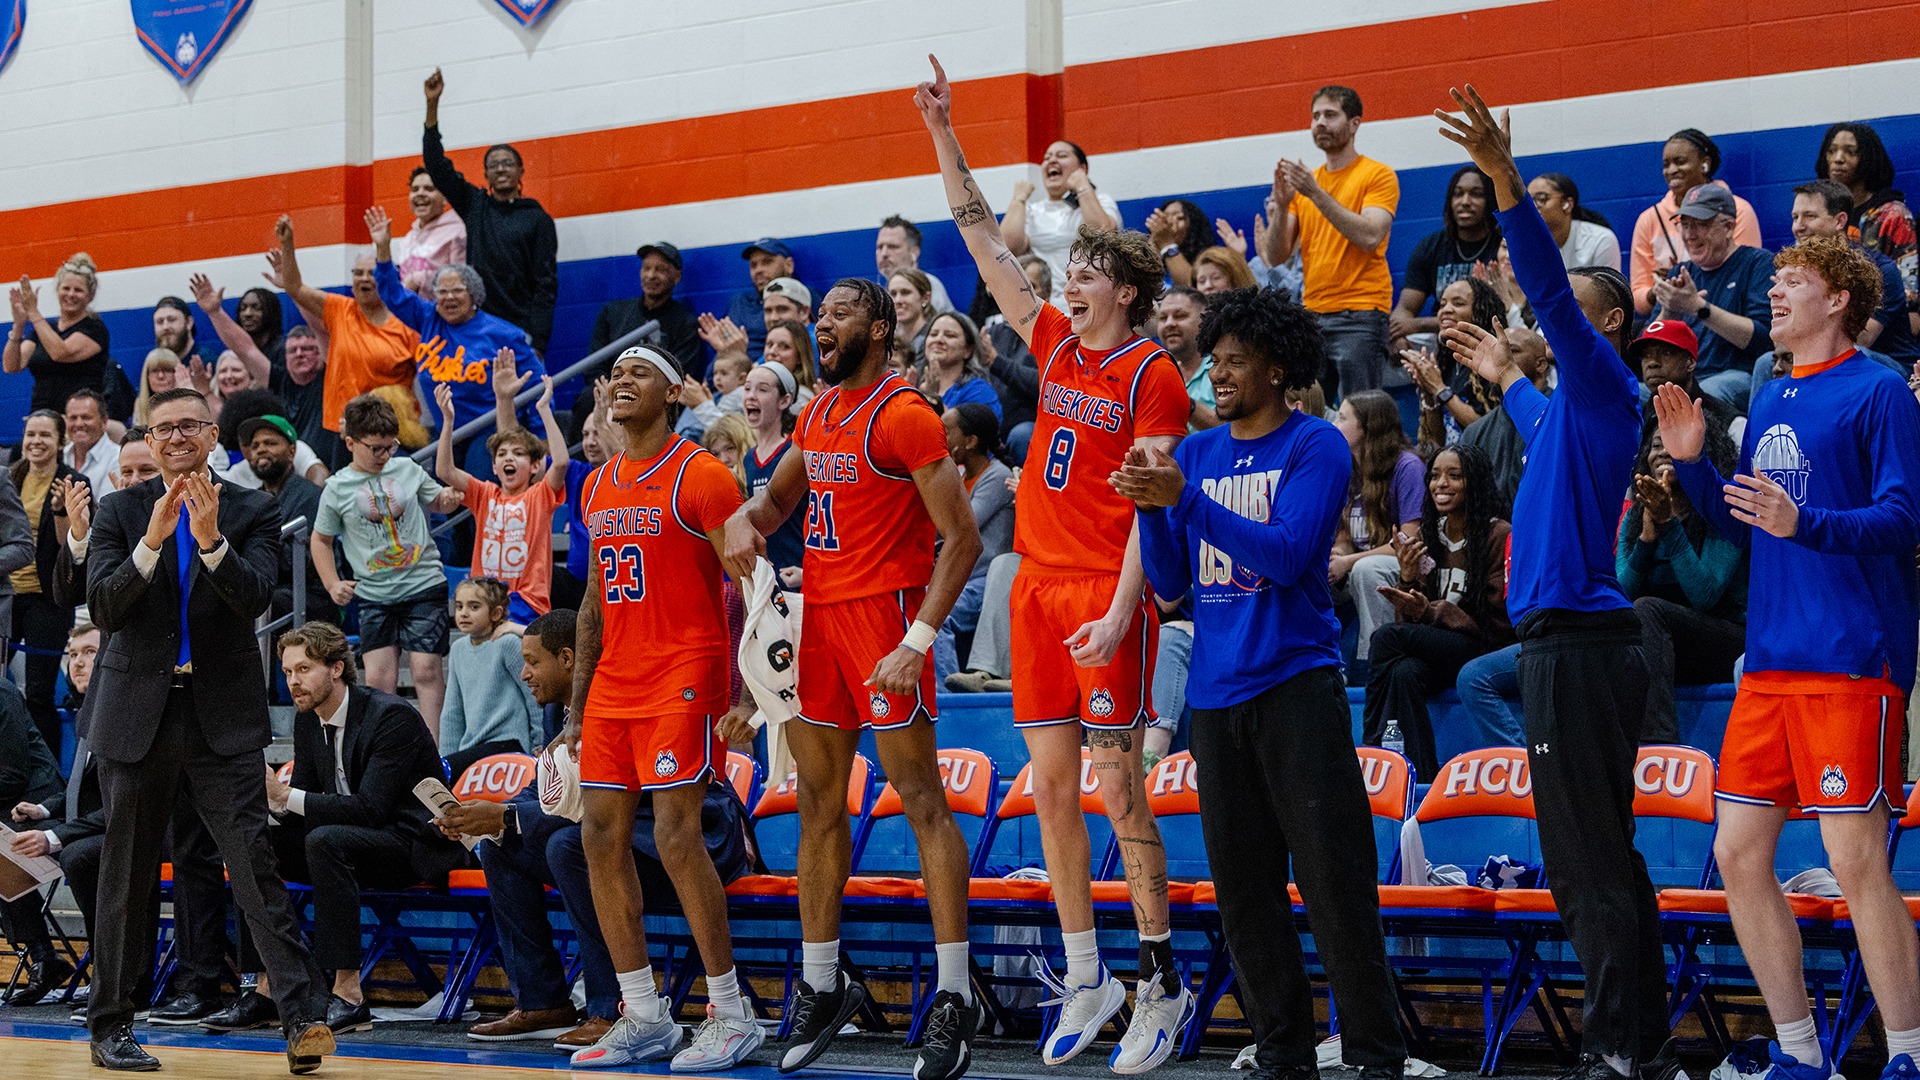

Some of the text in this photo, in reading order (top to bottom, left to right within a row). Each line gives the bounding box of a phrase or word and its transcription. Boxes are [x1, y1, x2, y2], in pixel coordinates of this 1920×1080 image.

[1043, 381, 1125, 433] HUSKIES
[1044, 426, 1077, 493] 8
[588, 506, 663, 541] HUSKIES
[805, 489, 841, 551] 21
[598, 543, 646, 604] 23
[1198, 538, 1233, 587] US
[459, 761, 527, 797] HCU
[1443, 757, 1533, 799] HCU
[1633, 755, 1699, 799] CU
